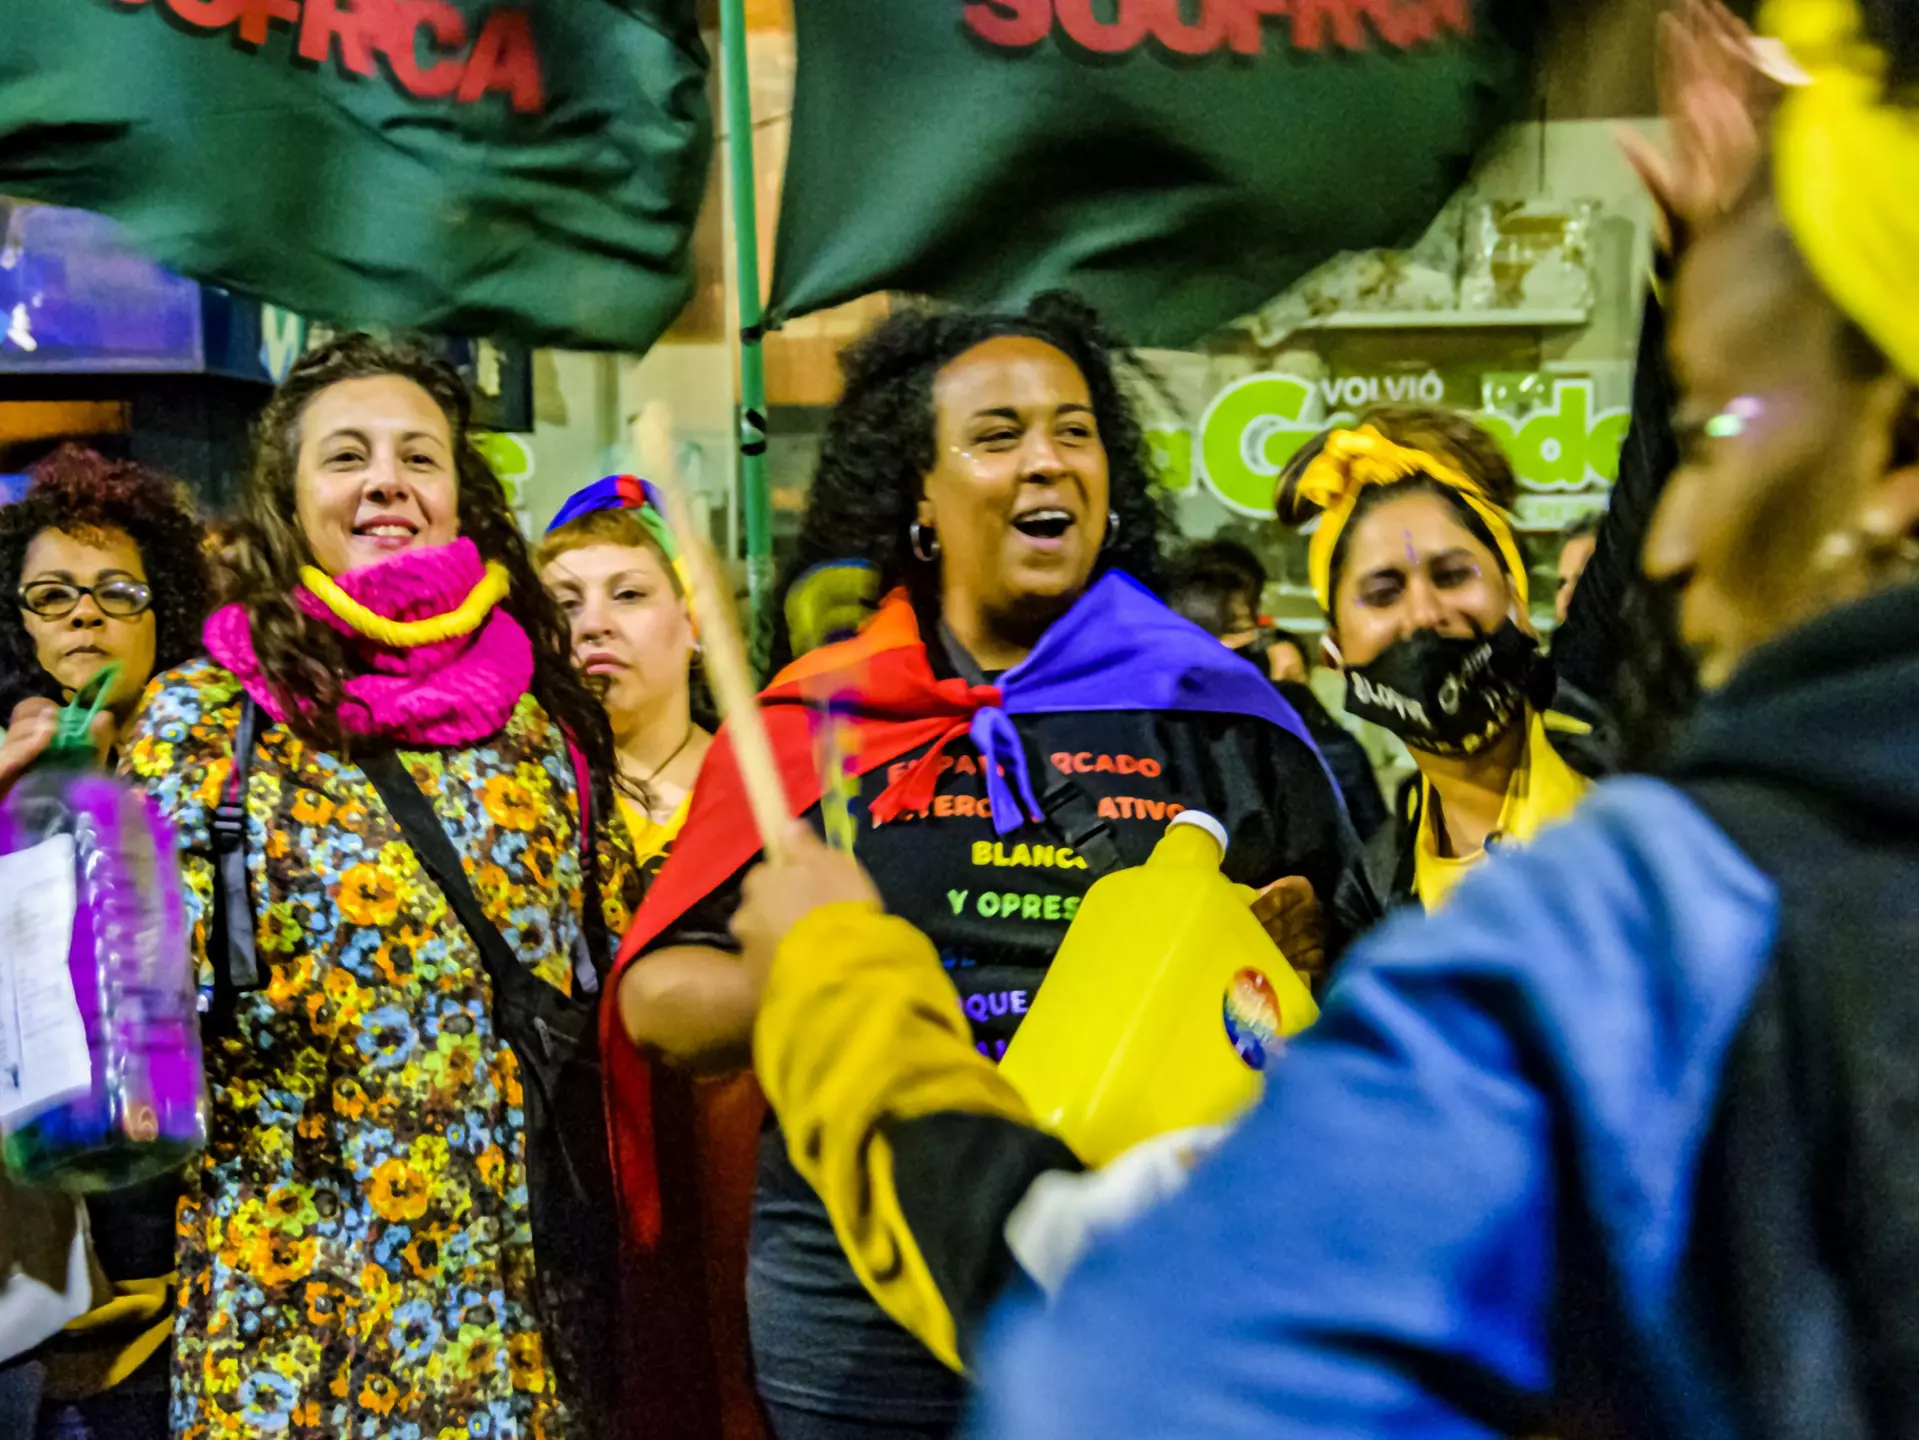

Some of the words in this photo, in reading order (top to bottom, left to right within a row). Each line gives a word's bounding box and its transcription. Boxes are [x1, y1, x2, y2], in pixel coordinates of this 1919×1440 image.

[1321, 369, 1444, 406] VOLVIÓ
[971, 841, 1088, 869] BLANC
[947, 889, 969, 916] Y
[957, 990, 1028, 1023] QUE
